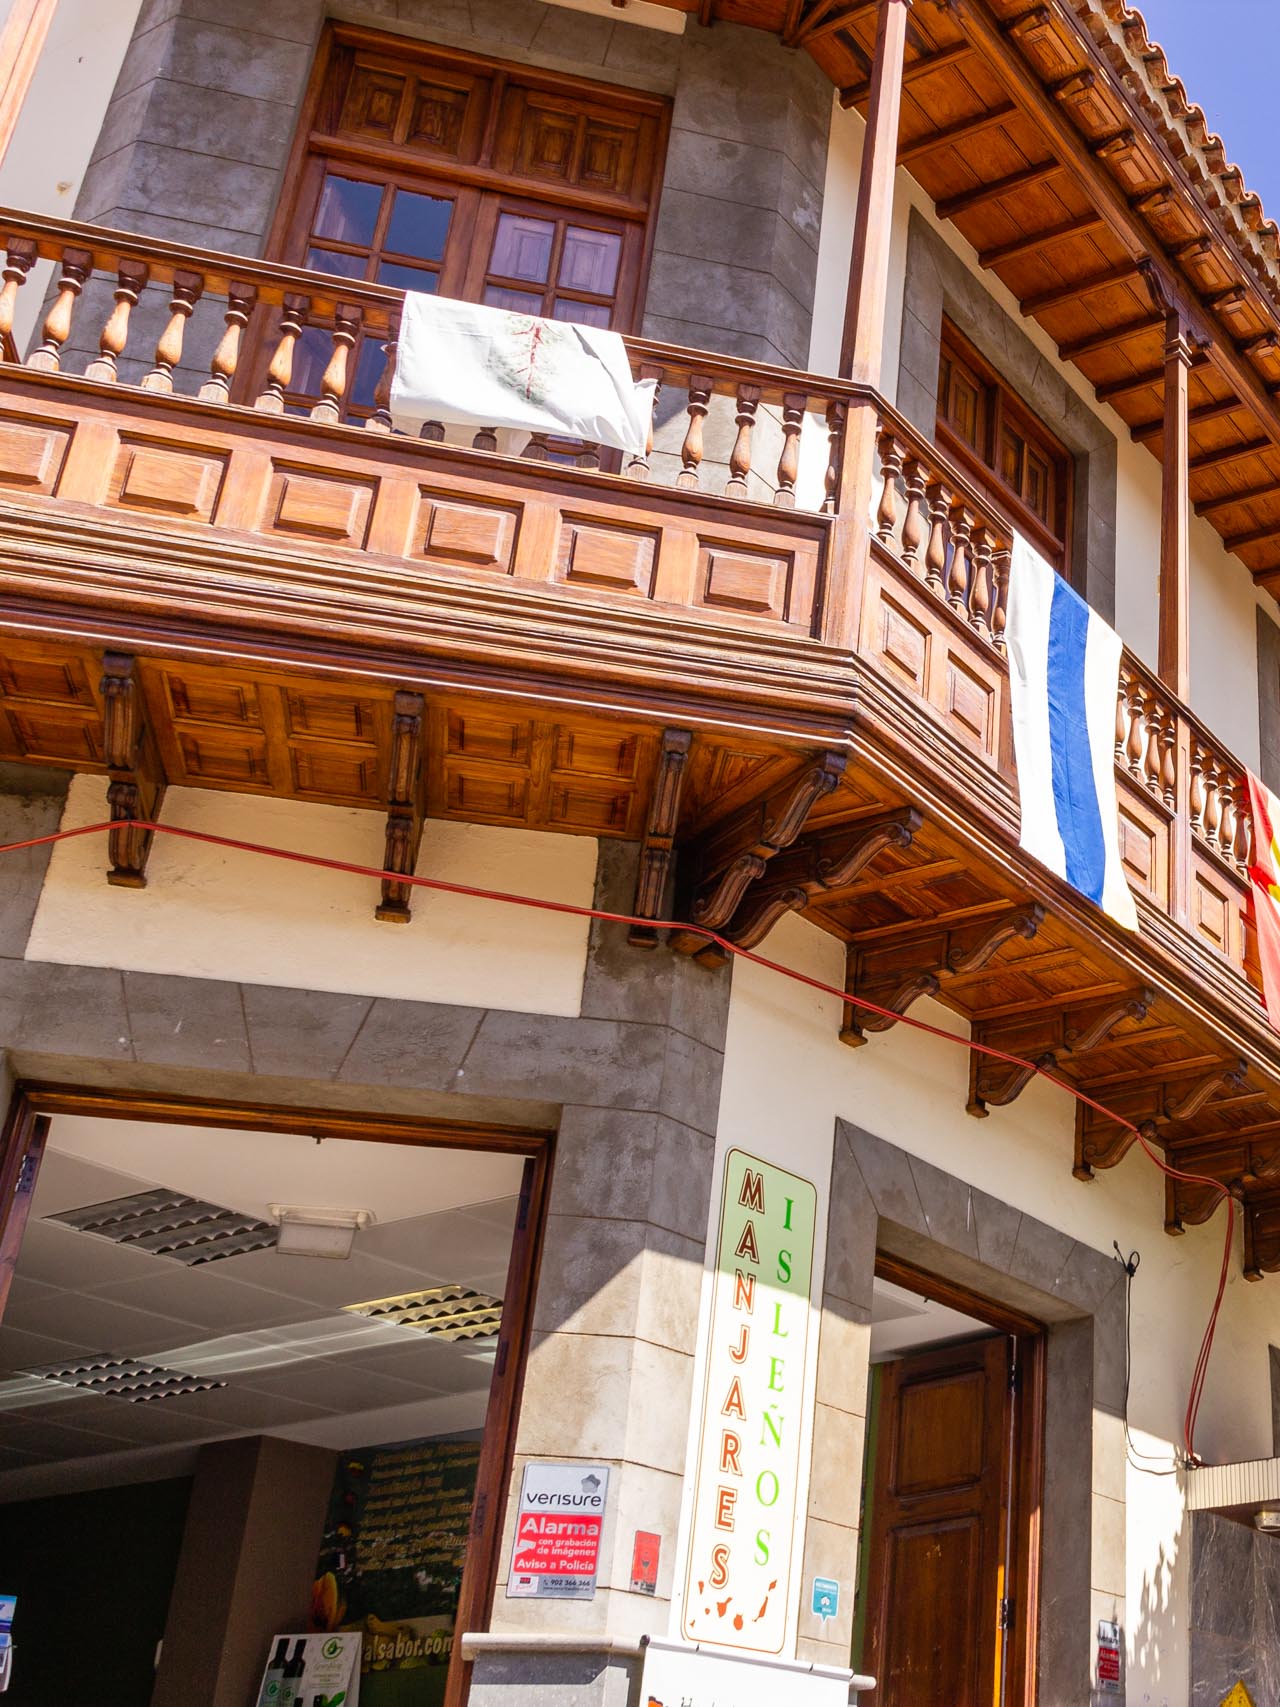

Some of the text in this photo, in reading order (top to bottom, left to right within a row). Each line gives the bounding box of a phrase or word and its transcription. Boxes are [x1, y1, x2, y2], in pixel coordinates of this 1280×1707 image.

[709, 1168, 765, 1590] MANJARES
[754, 1197, 794, 1567] ISLEÑOS
[526, 1492, 602, 1507] verisure
[521, 1517, 599, 1536] Alarma
[538, 1538, 597, 1548] con grabación
[537, 1546, 596, 1558] de imágenes
[516, 1558, 594, 1571] Aviso a Policía
